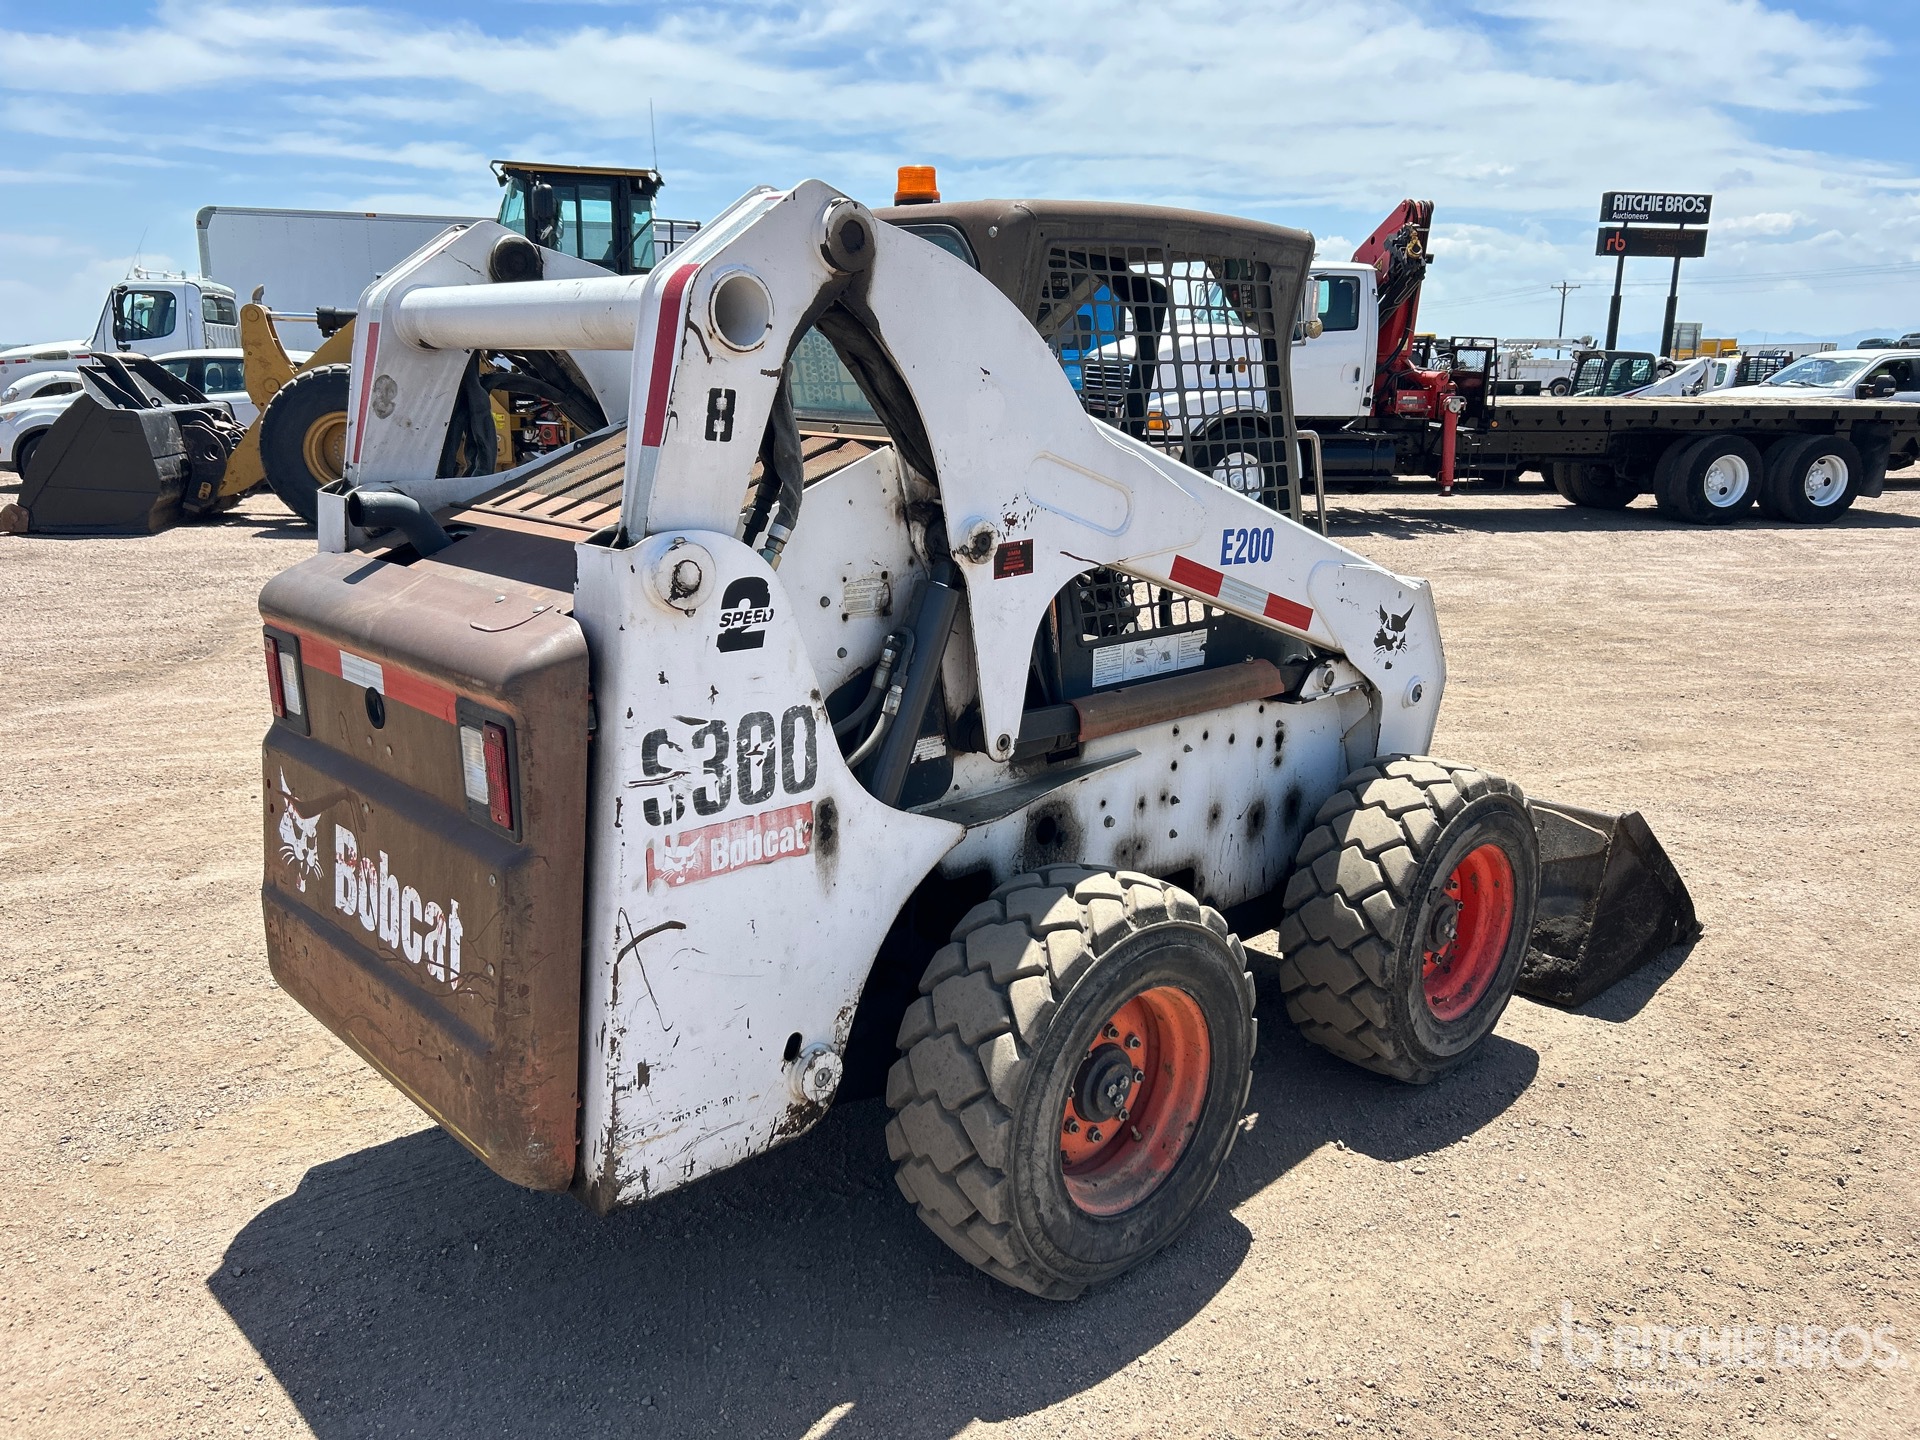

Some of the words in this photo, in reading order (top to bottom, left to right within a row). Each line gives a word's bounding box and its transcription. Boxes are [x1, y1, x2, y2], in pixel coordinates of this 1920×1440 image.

[1612, 211, 1649, 221] Auctioneers
[1613, 194, 1664, 212] RITCHIE
[1665, 196, 1707, 214] BROS.
[1606, 231, 1627, 251] rb
[705, 387, 736, 442] 8
[1220, 527, 1275, 566] E200
[716, 576, 770, 653] 2
[719, 608, 774, 628] SPEED
[641, 704, 819, 827] S300
[709, 818, 809, 873] Bobcat
[335, 823, 464, 991] Bobcat
